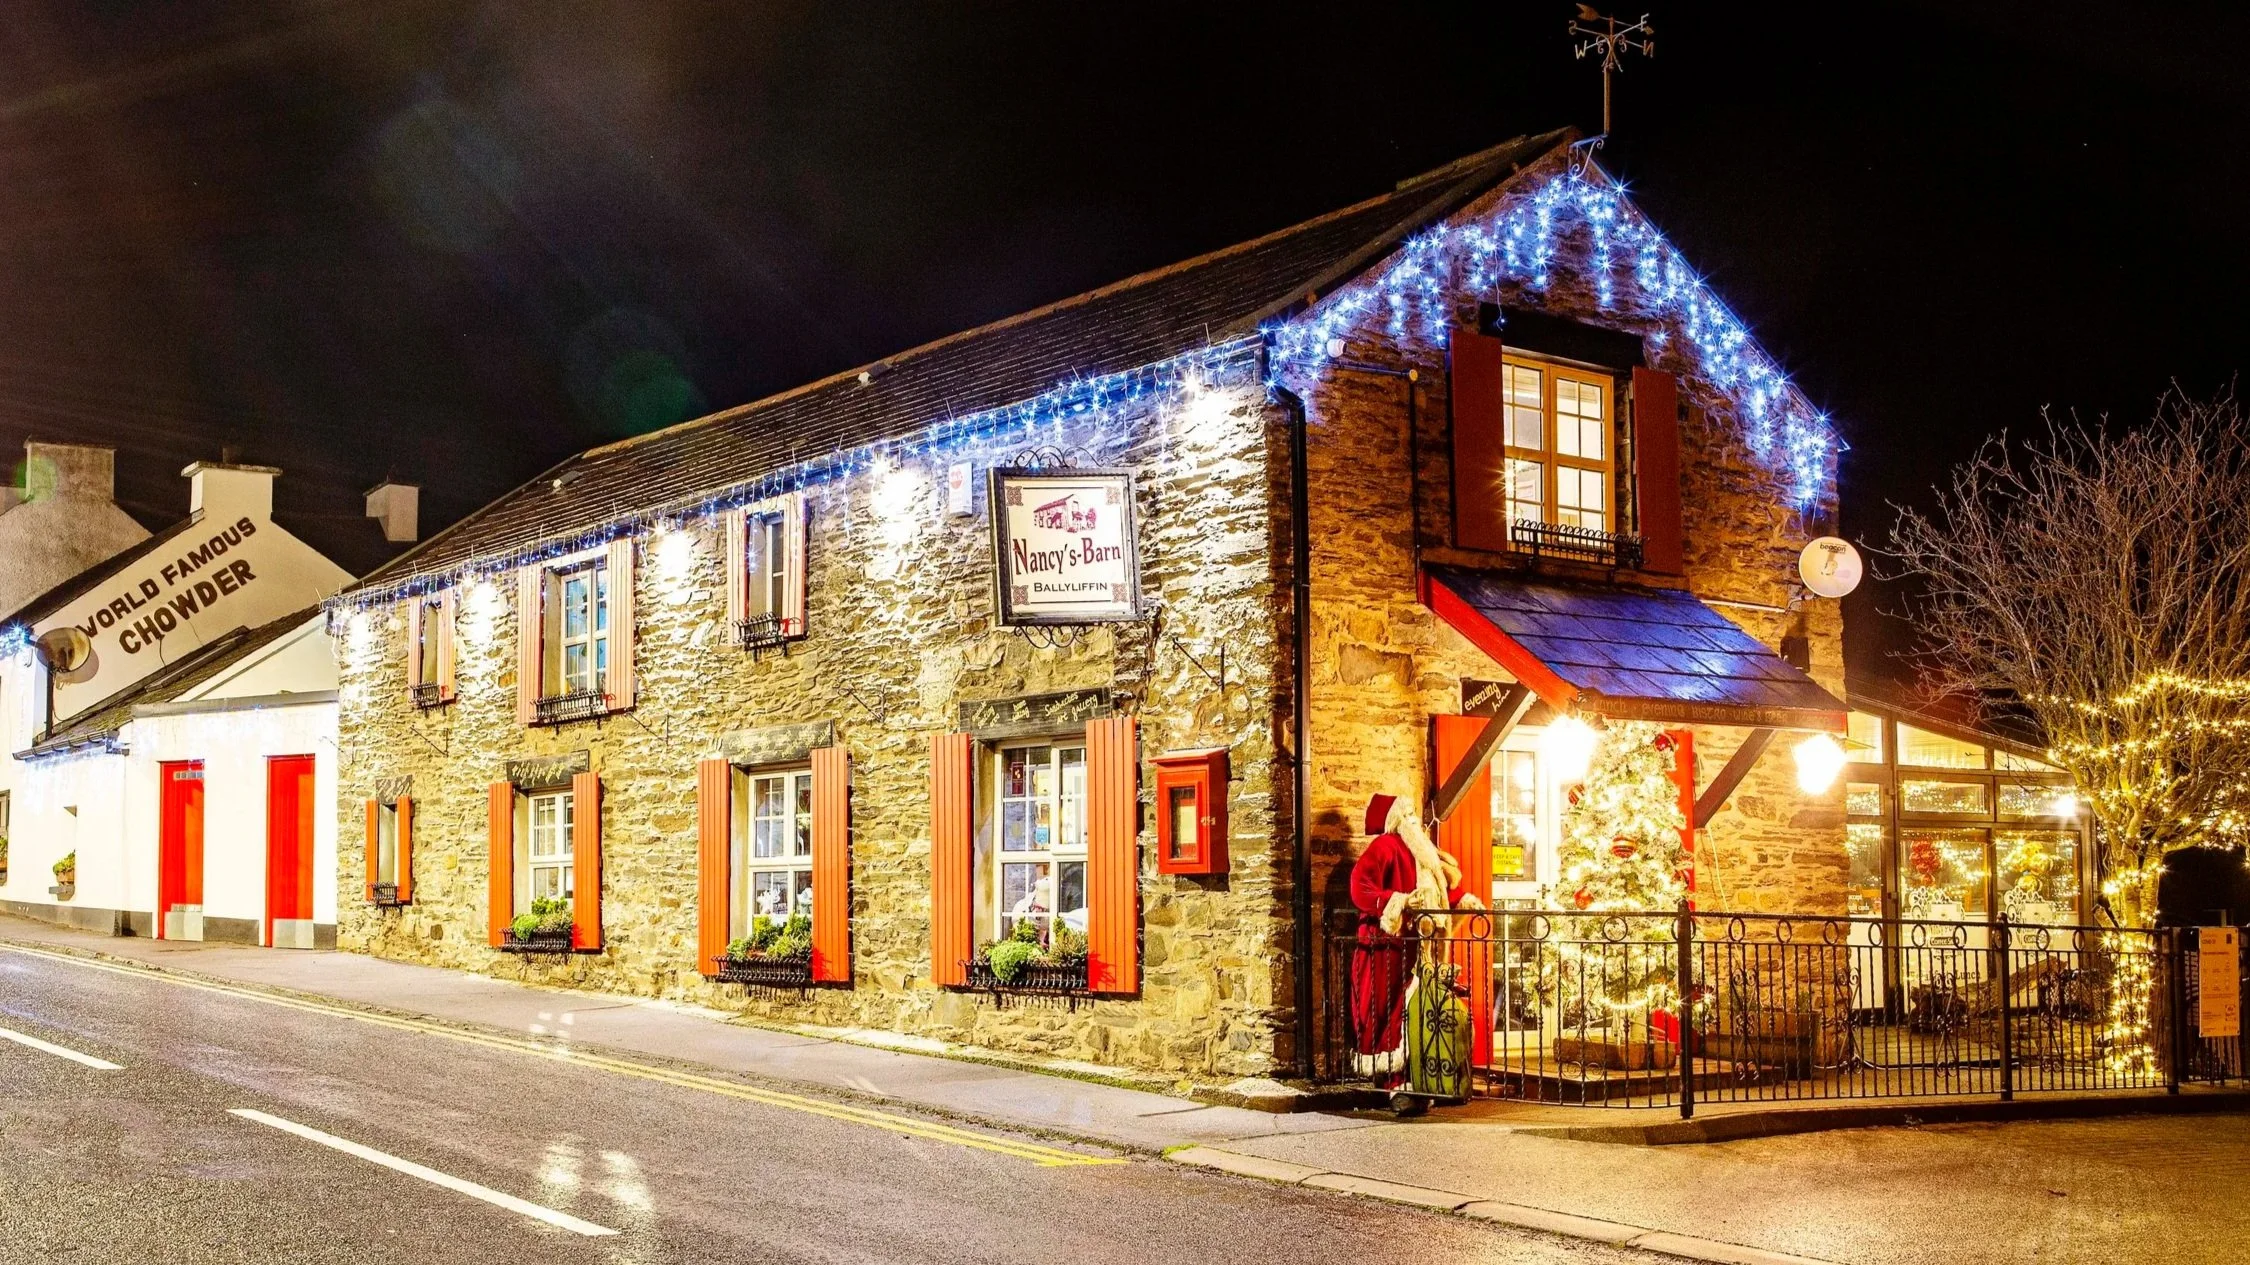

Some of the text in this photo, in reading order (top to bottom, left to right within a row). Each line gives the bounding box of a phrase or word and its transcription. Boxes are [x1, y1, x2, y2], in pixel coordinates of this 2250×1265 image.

[1575, 40, 1587, 60] W
[1820, 542, 1846, 553] beacon
[76, 517, 256, 638] WORLD FAMOUS
[1034, 582, 1108, 592] BALLYLIFFIN
[119, 559, 256, 654] CHOWDER
[1464, 682, 1502, 711] evening
